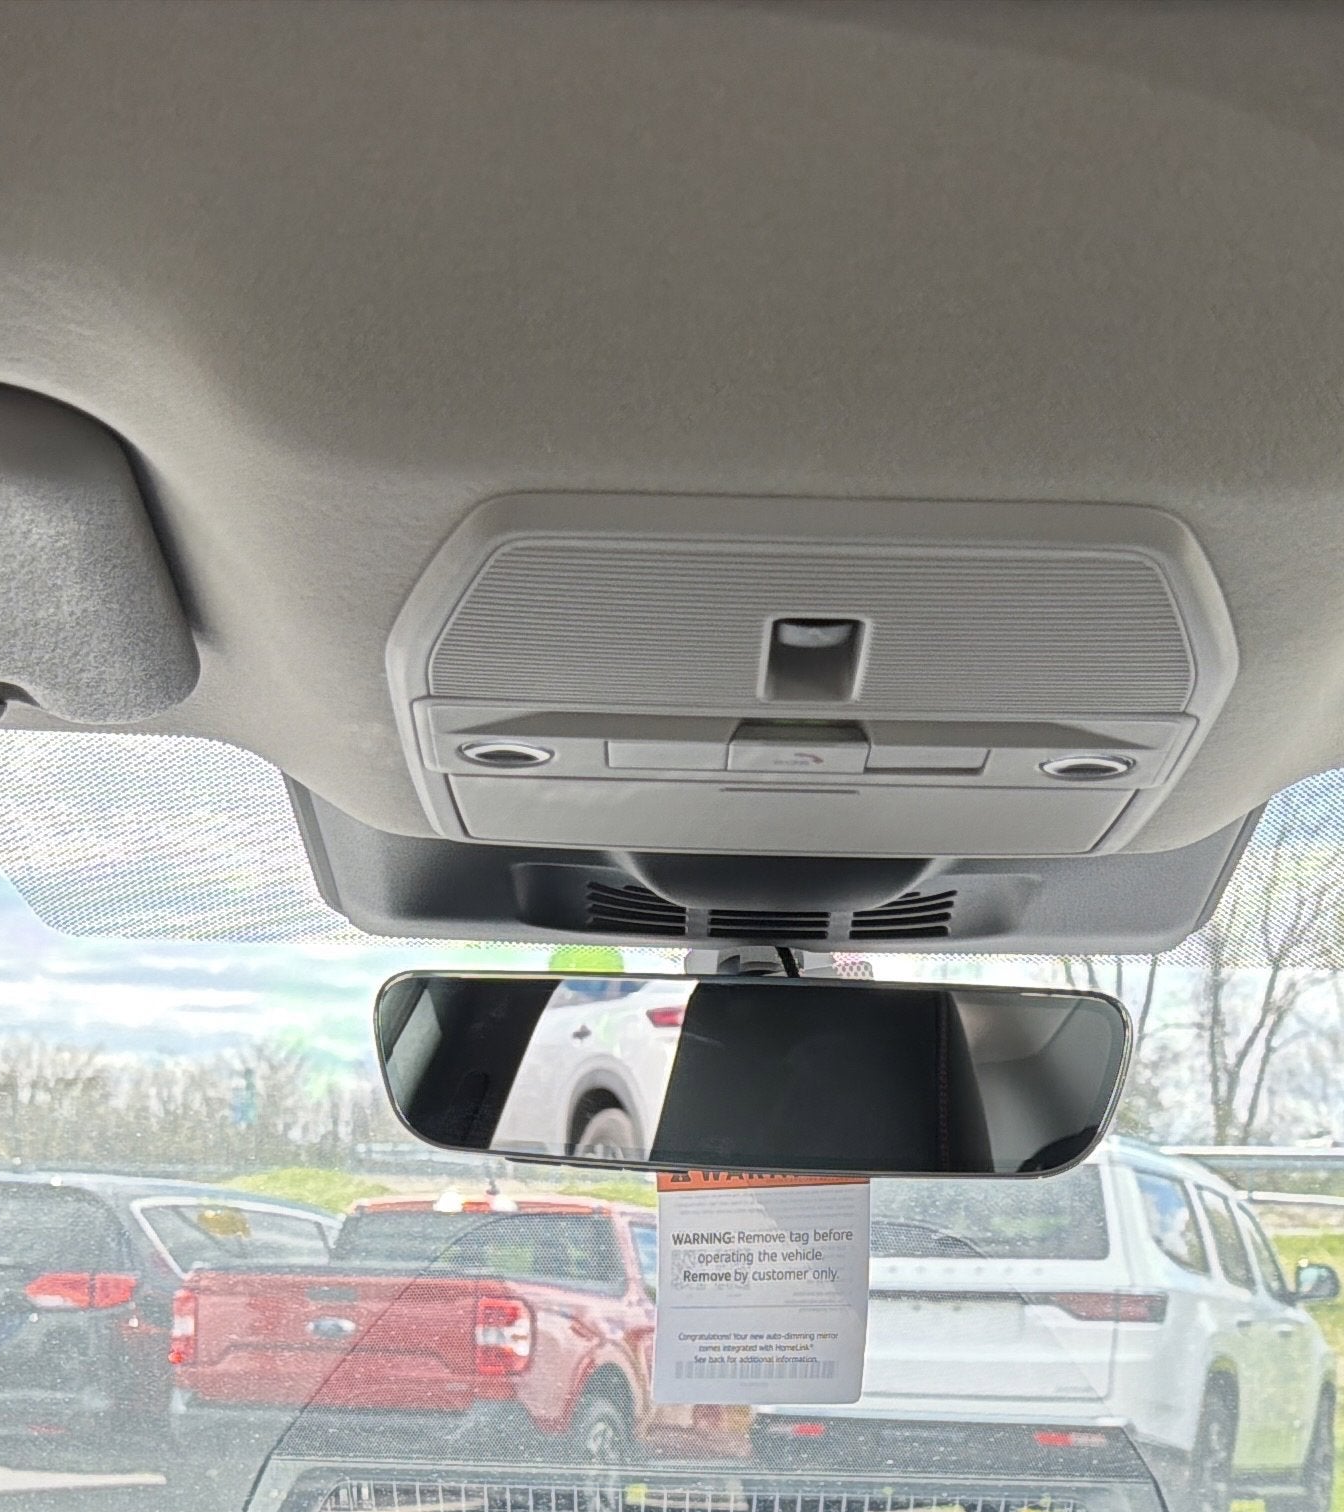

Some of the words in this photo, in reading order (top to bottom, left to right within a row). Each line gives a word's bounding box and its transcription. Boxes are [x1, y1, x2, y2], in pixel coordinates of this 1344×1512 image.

[672, 1231, 736, 1246] WARNING:
[738, 1231, 786, 1244] Remove
[789, 1231, 809, 1245] tag
[814, 1228, 853, 1241] before
[698, 1250, 754, 1265] operating
[758, 1249, 777, 1262] the
[683, 1270, 731, 1283] Remove
[734, 1269, 748, 1284] by
[752, 1268, 808, 1281] customer
[812, 1267, 839, 1282] only.
